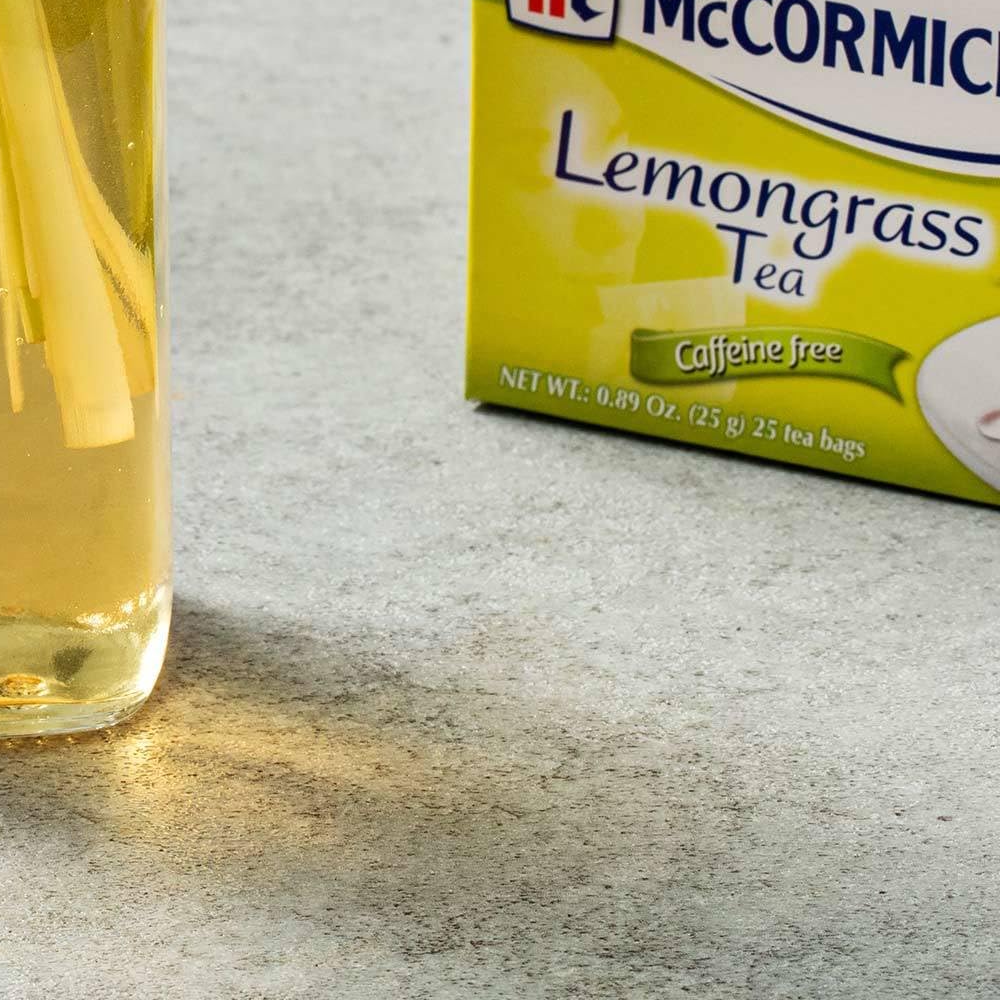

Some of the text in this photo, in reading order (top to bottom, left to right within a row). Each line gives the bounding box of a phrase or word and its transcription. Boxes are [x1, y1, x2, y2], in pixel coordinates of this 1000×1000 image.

[555, 109, 984, 260] Lemongrass
[716, 223, 805, 297] Tea
[675, 334, 843, 375] Caffeine free
[500, 365, 542, 393] NET
[597, 385, 640, 412] 0.89
[647, 395, 681, 422] Oz.
[689, 403, 722, 429] (25
[725, 414, 746, 439] g)
[752, 417, 778, 441] 25
[784, 423, 814, 449] tea
[820, 427, 866, 463] bags
